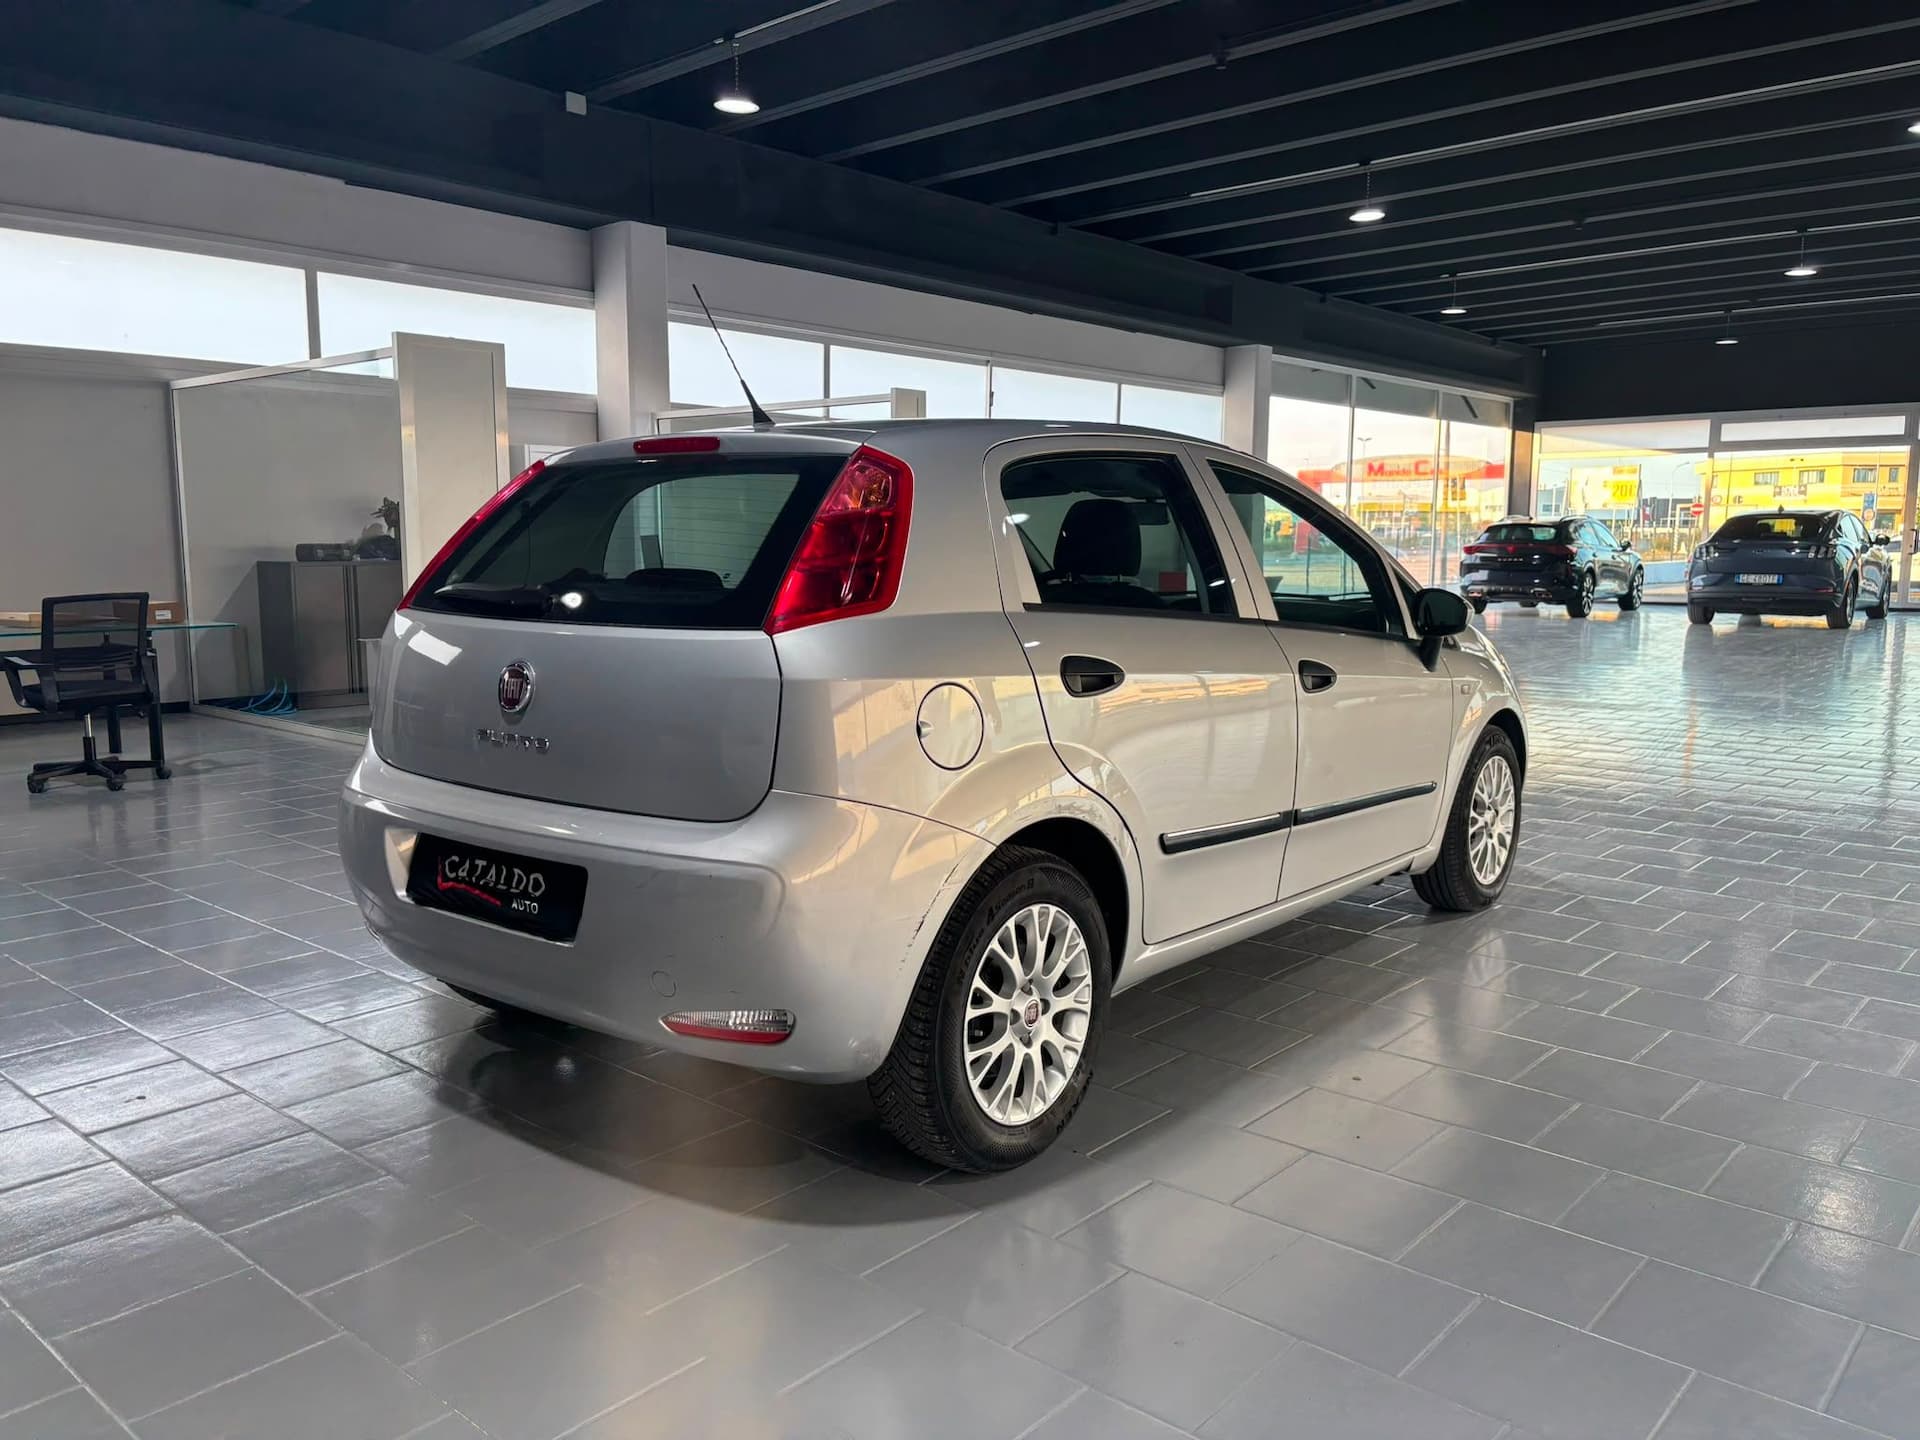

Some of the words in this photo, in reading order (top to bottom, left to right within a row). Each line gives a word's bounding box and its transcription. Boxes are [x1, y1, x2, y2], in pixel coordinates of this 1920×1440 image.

[503, 676, 523, 699] FIAT
[444, 855, 546, 897] CATALDO
[511, 899, 539, 914] AUTO
